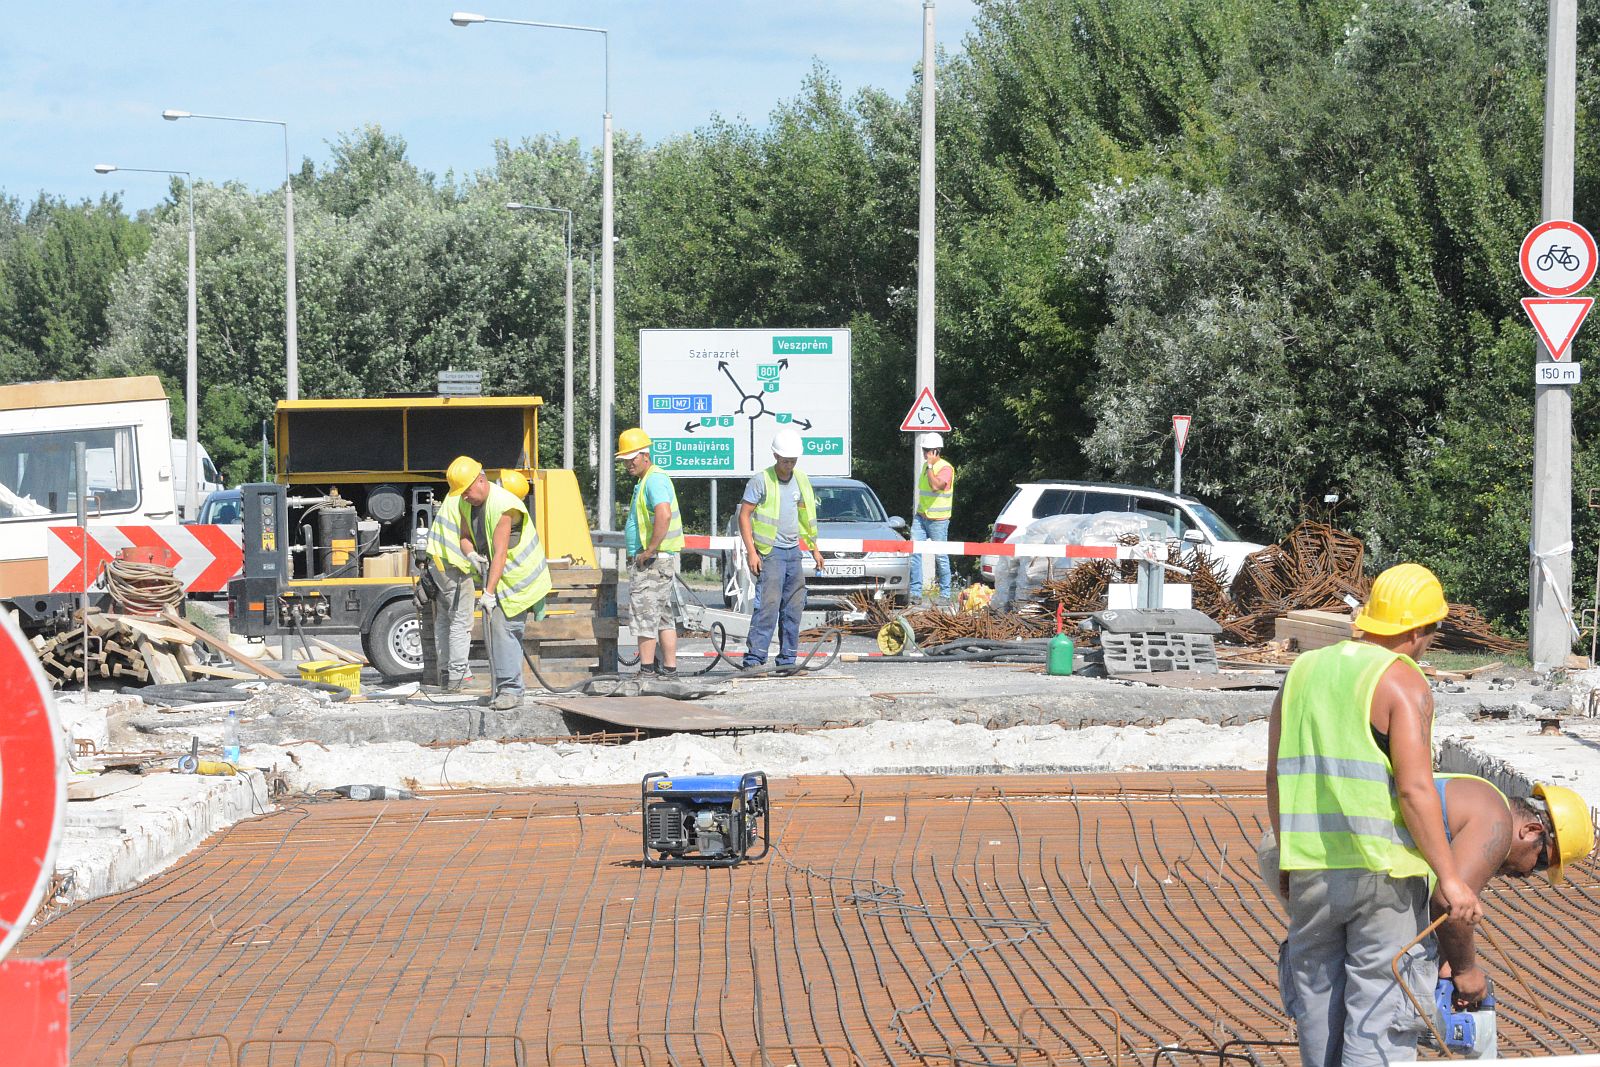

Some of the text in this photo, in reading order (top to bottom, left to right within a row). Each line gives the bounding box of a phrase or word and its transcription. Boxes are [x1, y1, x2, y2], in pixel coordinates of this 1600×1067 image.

[777, 339, 828, 351] Veszprém
[689, 349, 740, 359] Szárazrét
[760, 367, 777, 377] 801
[1541, 367, 1575, 379] 150 m
[676, 399, 687, 408] M7
[706, 418, 711, 426] 7
[723, 418, 729, 426] 8
[781, 414, 787, 422] 7
[657, 442, 668, 450] 62
[675, 441, 730, 452] Dunaújváros
[807, 440, 839, 453] Győr
[657, 457, 668, 465] 63
[676, 455, 730, 466] Szekszárd
[824, 566, 863, 575] NVL-281
